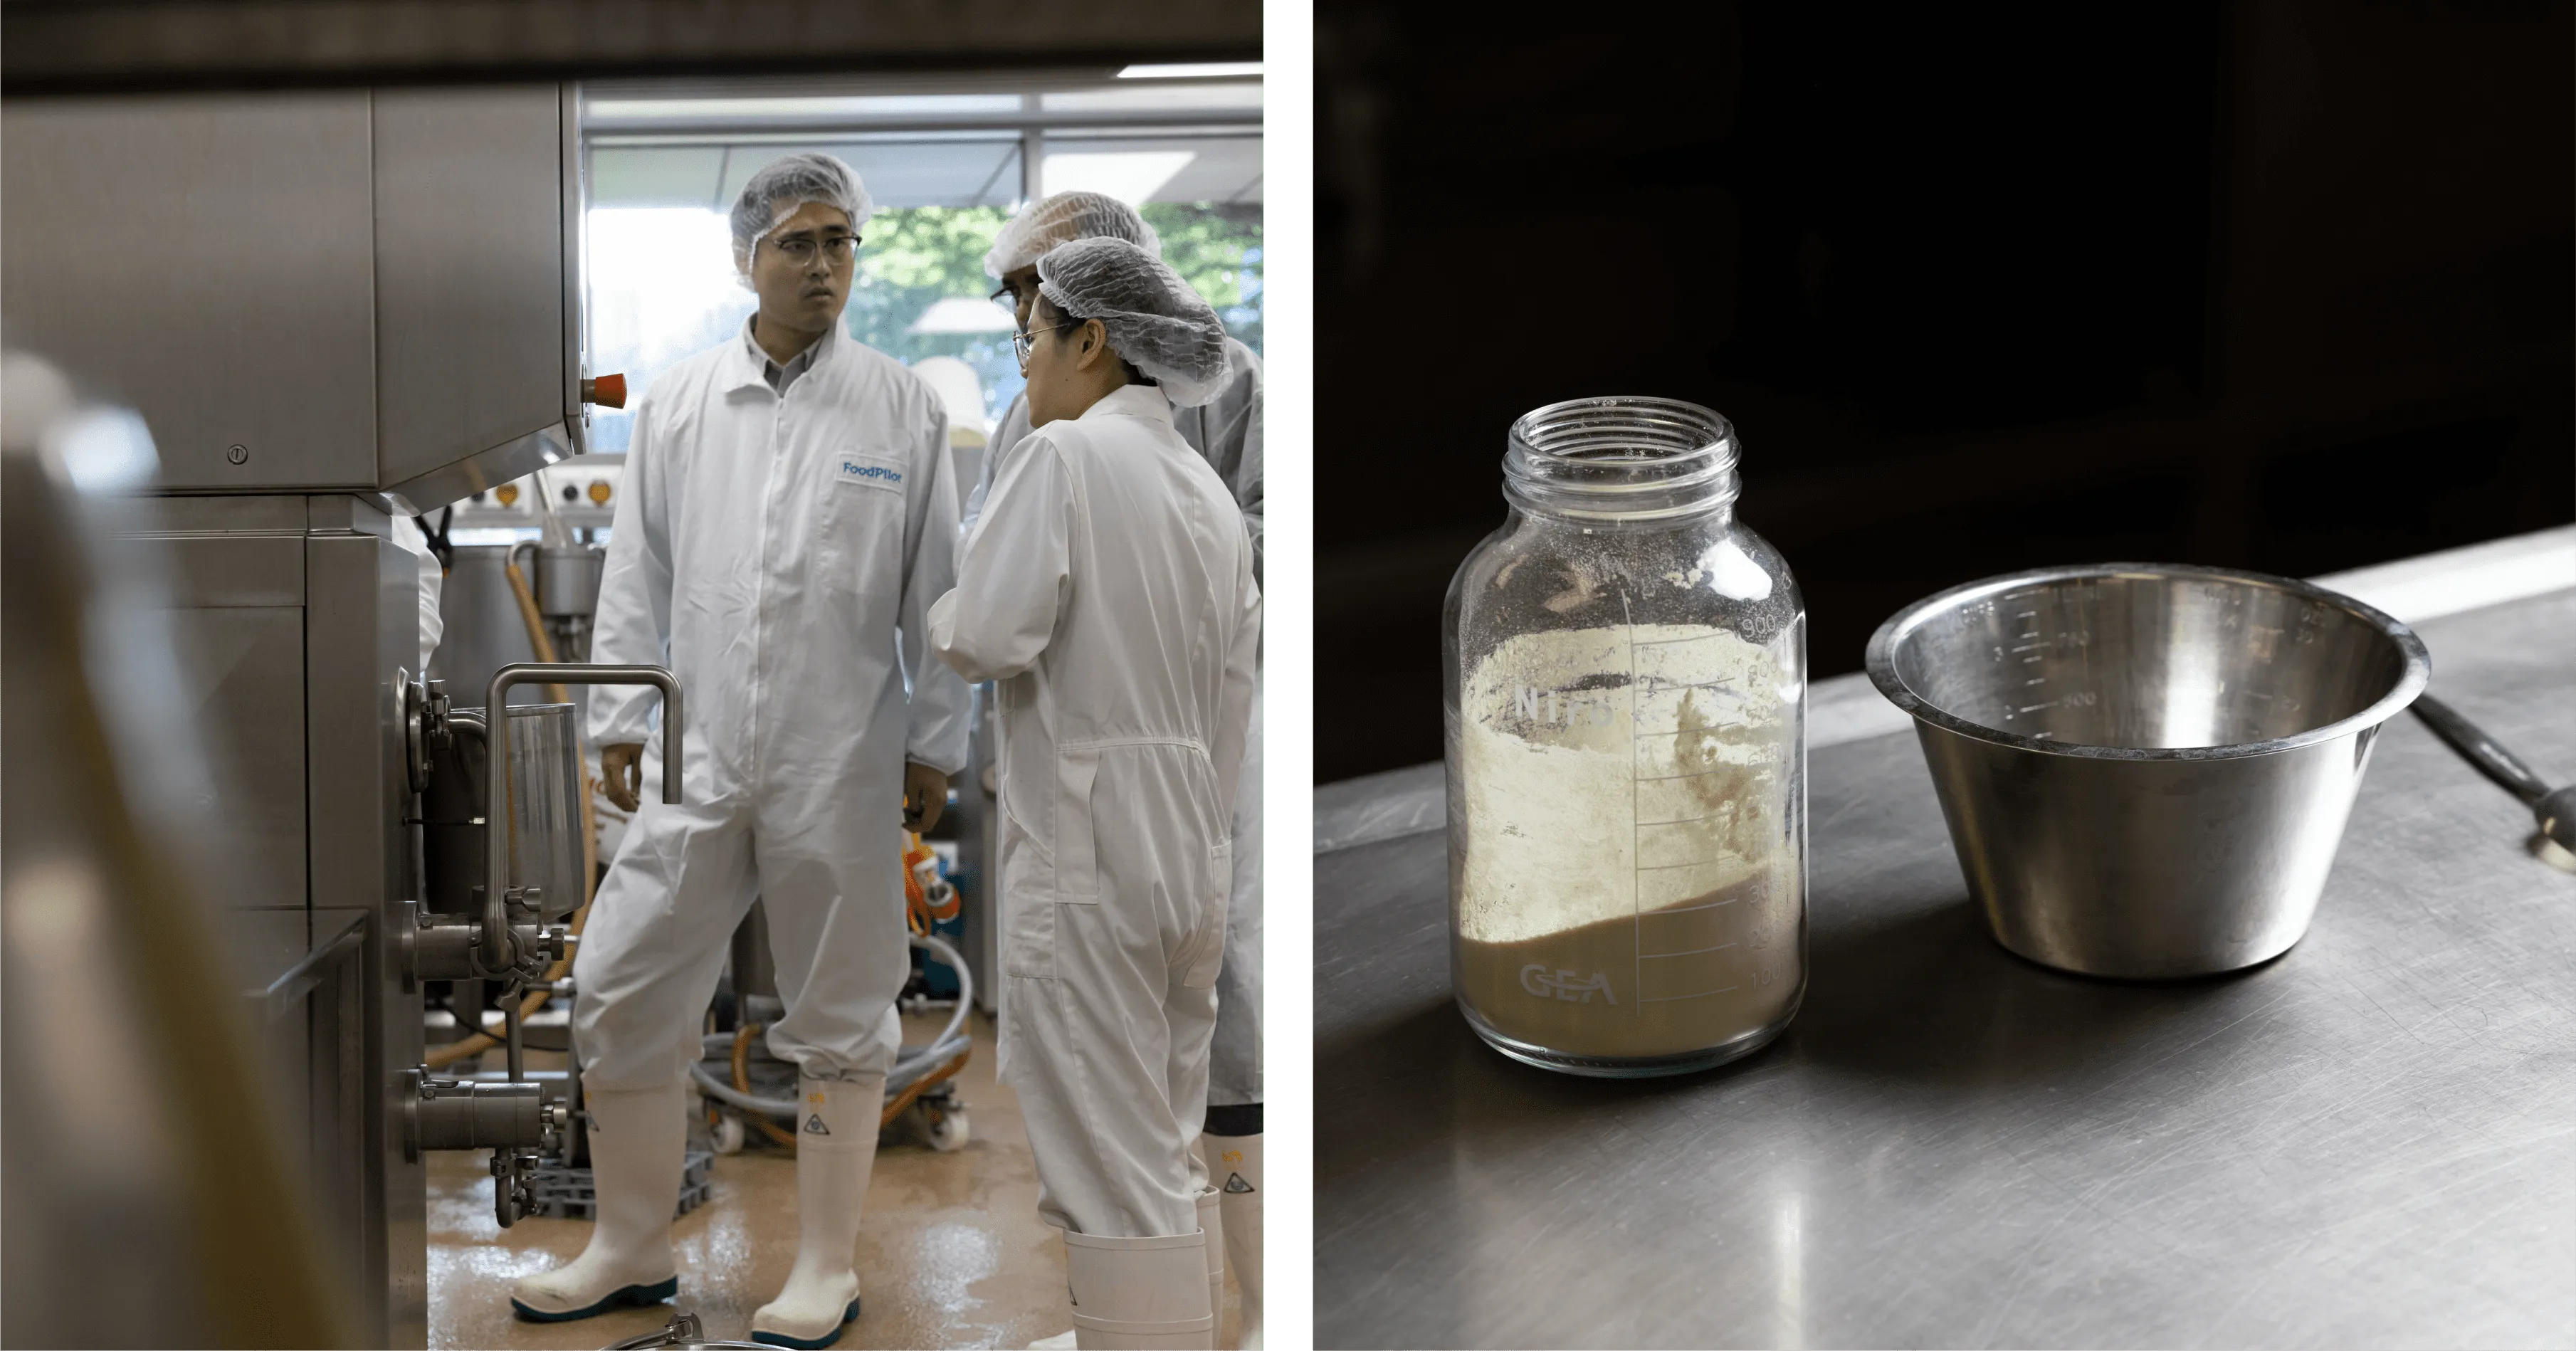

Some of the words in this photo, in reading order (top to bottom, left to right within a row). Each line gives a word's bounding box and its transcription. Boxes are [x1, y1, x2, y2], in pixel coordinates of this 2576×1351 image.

[1742, 614, 1776, 638] 900
[1514, 683, 1615, 727] Niro
[1520, 963, 1619, 1006] GEA
